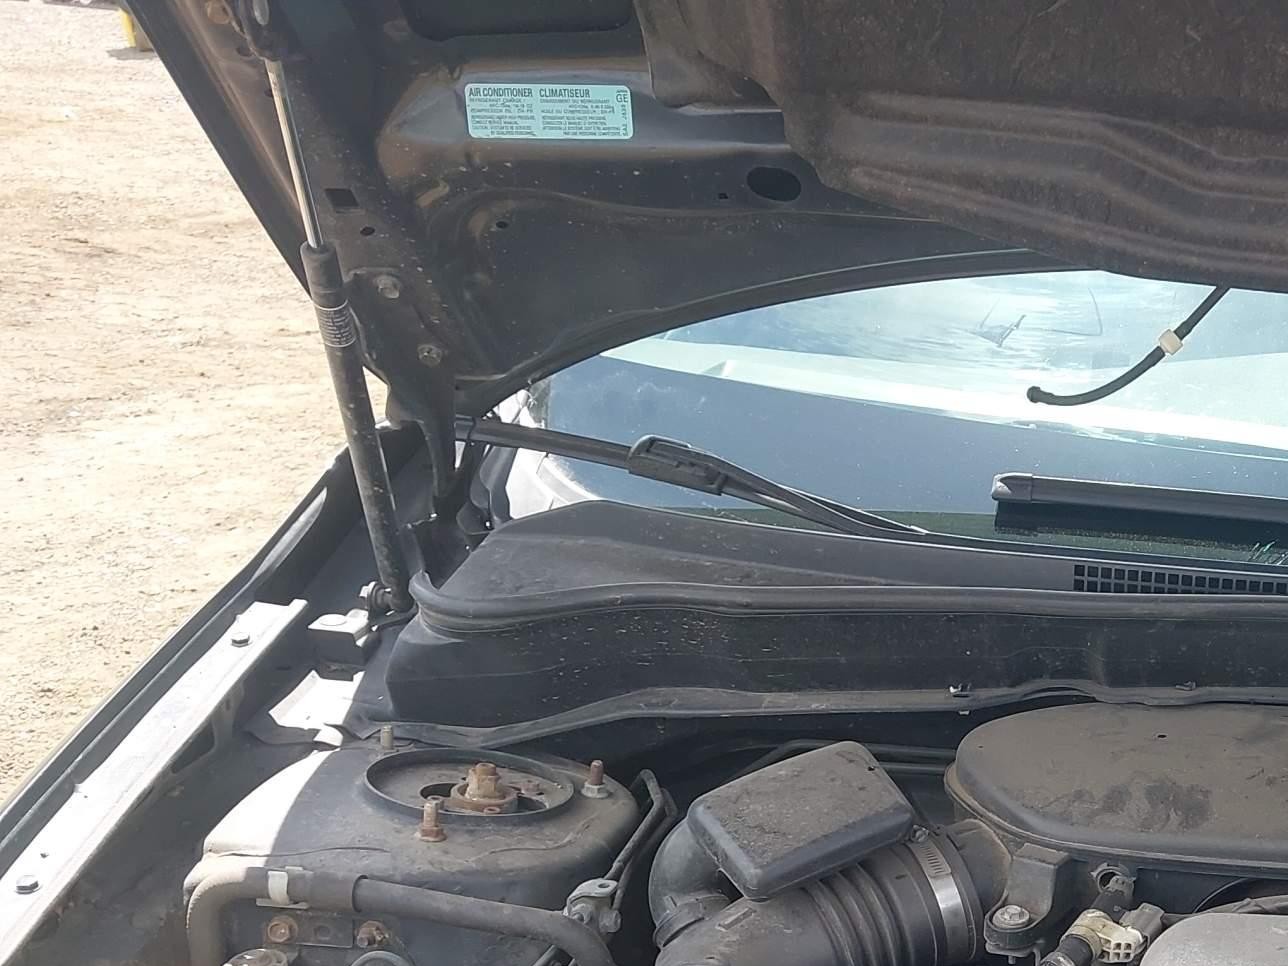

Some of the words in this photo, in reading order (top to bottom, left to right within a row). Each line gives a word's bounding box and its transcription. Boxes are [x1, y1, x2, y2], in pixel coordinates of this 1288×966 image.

[468, 88, 481, 97] AIR
[482, 88, 533, 98] CONDITIONER
[539, 88, 591, 98] CLIMATISEUR
[616, 93, 629, 103] GE
